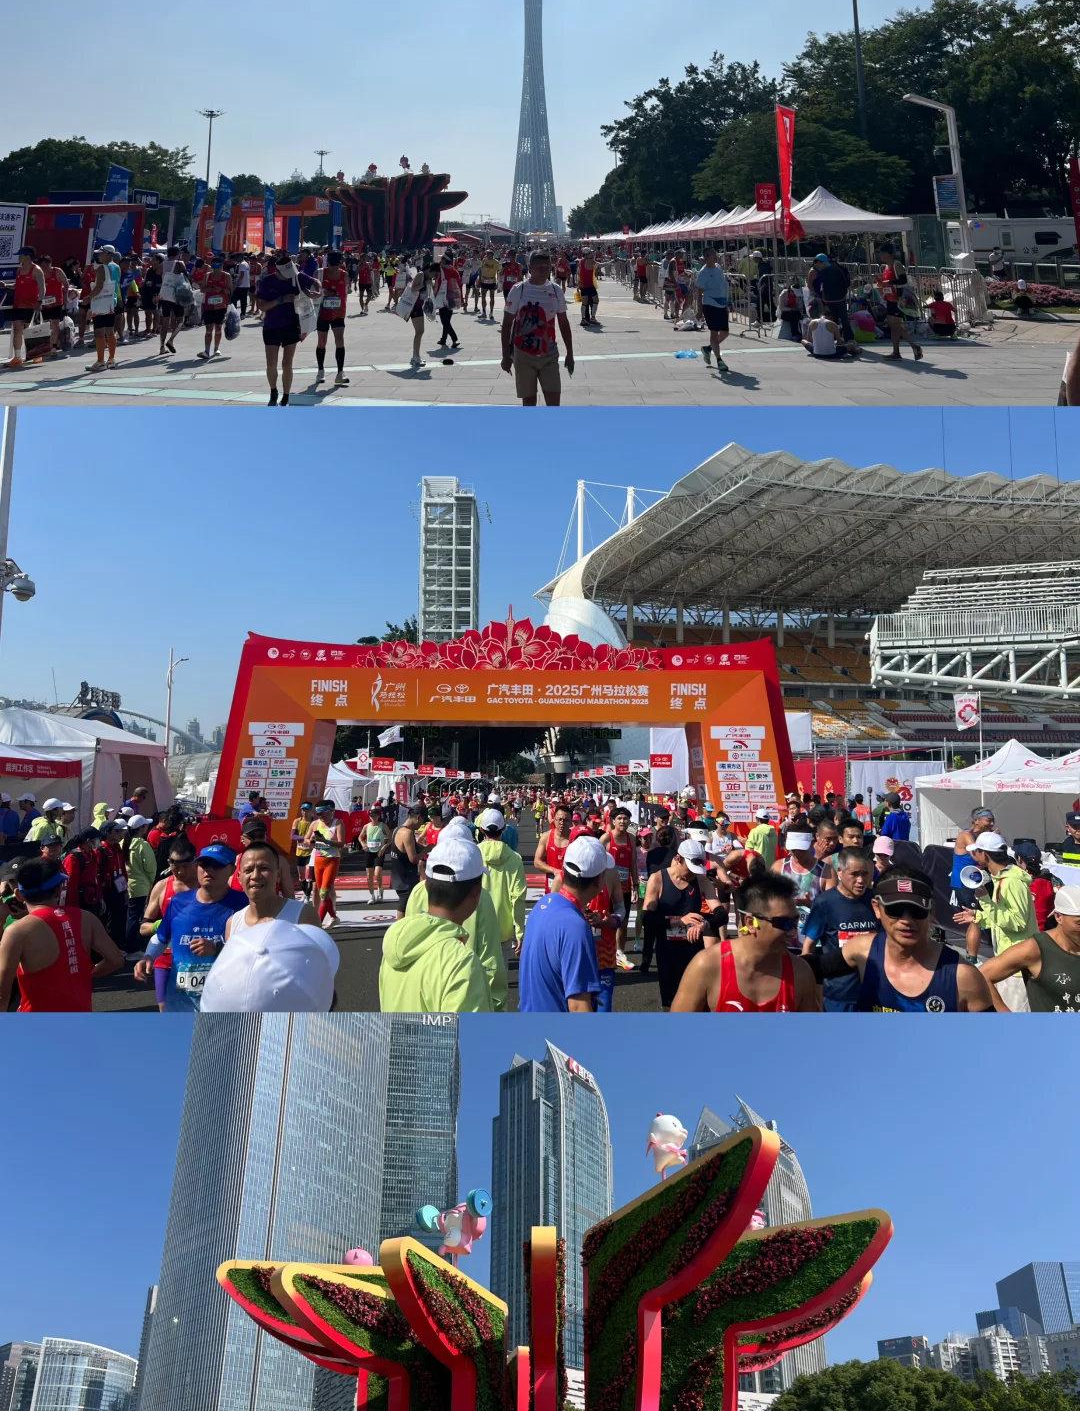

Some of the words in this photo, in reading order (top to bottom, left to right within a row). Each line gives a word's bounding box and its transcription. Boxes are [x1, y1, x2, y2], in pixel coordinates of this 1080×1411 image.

[311, 680, 348, 692] FINISH
[385, 683, 406, 691] 广州
[487, 684, 533, 695] 广汽丰田
[545, 684, 649, 697] 2025广州马拉松赛
[670, 683, 706, 695] FINISH
[379, 691, 406, 699] 马拉松
[429, 695, 476, 703] 广汽丰田
[6, 763, 33, 773] 裁判工作区
[839, 921, 876, 930] GARMIN
[422, 1015, 451, 1026] IMP
